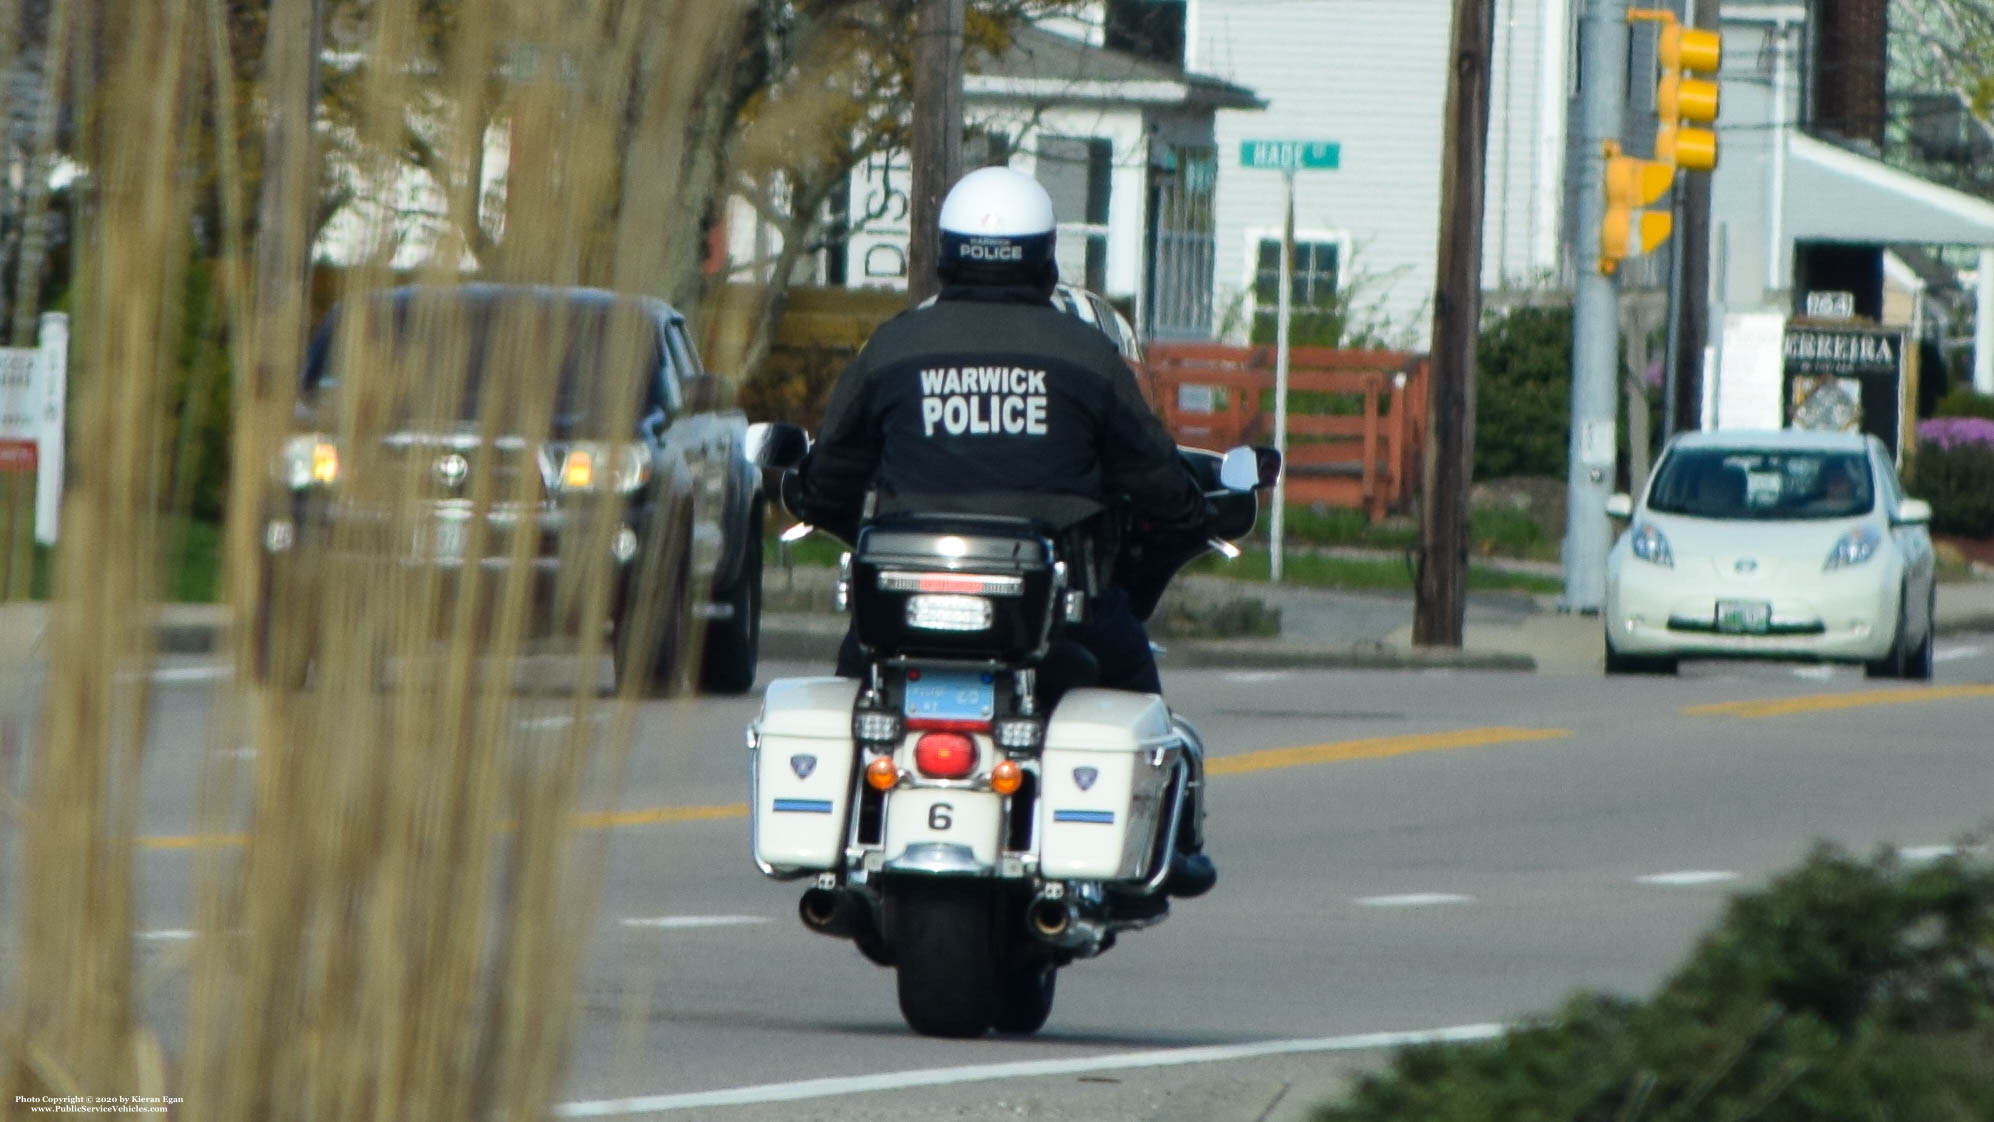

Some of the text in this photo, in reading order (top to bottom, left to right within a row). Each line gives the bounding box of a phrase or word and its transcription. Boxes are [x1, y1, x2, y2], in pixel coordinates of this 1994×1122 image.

[960, 245, 1023, 260] POLICE
[1783, 332, 1893, 361] ERREIRA
[920, 367, 1047, 395] WARWICK
[922, 395, 1048, 436] POLICE
[928, 803, 953, 830] 6
